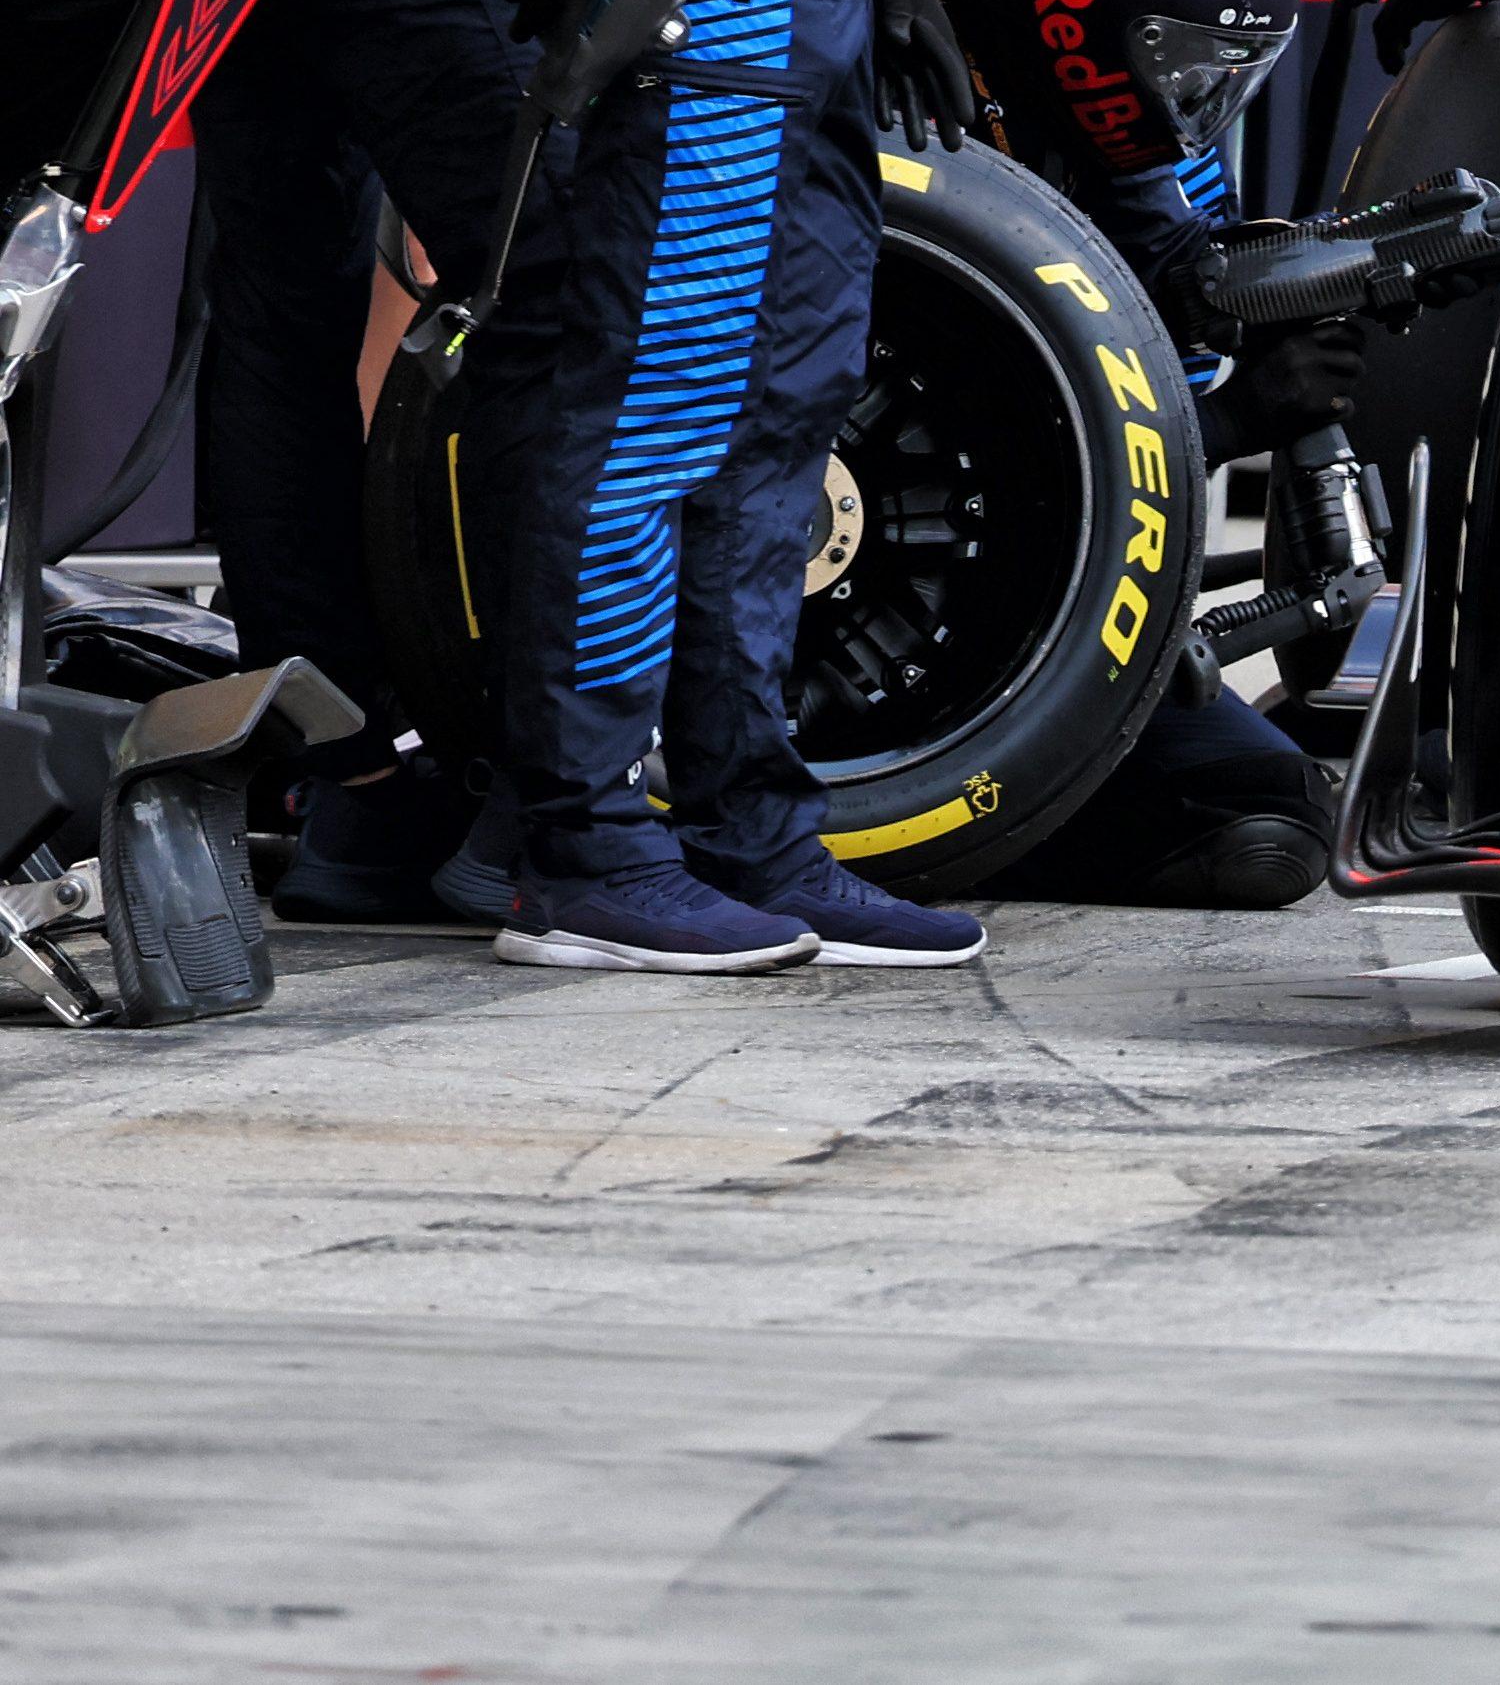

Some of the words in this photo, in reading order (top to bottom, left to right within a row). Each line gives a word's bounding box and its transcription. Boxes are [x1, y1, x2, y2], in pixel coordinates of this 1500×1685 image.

[1073, 94, 1166, 175] Bull
[1035, 261, 1110, 314] P
[1094, 345, 1172, 667] ZERO
